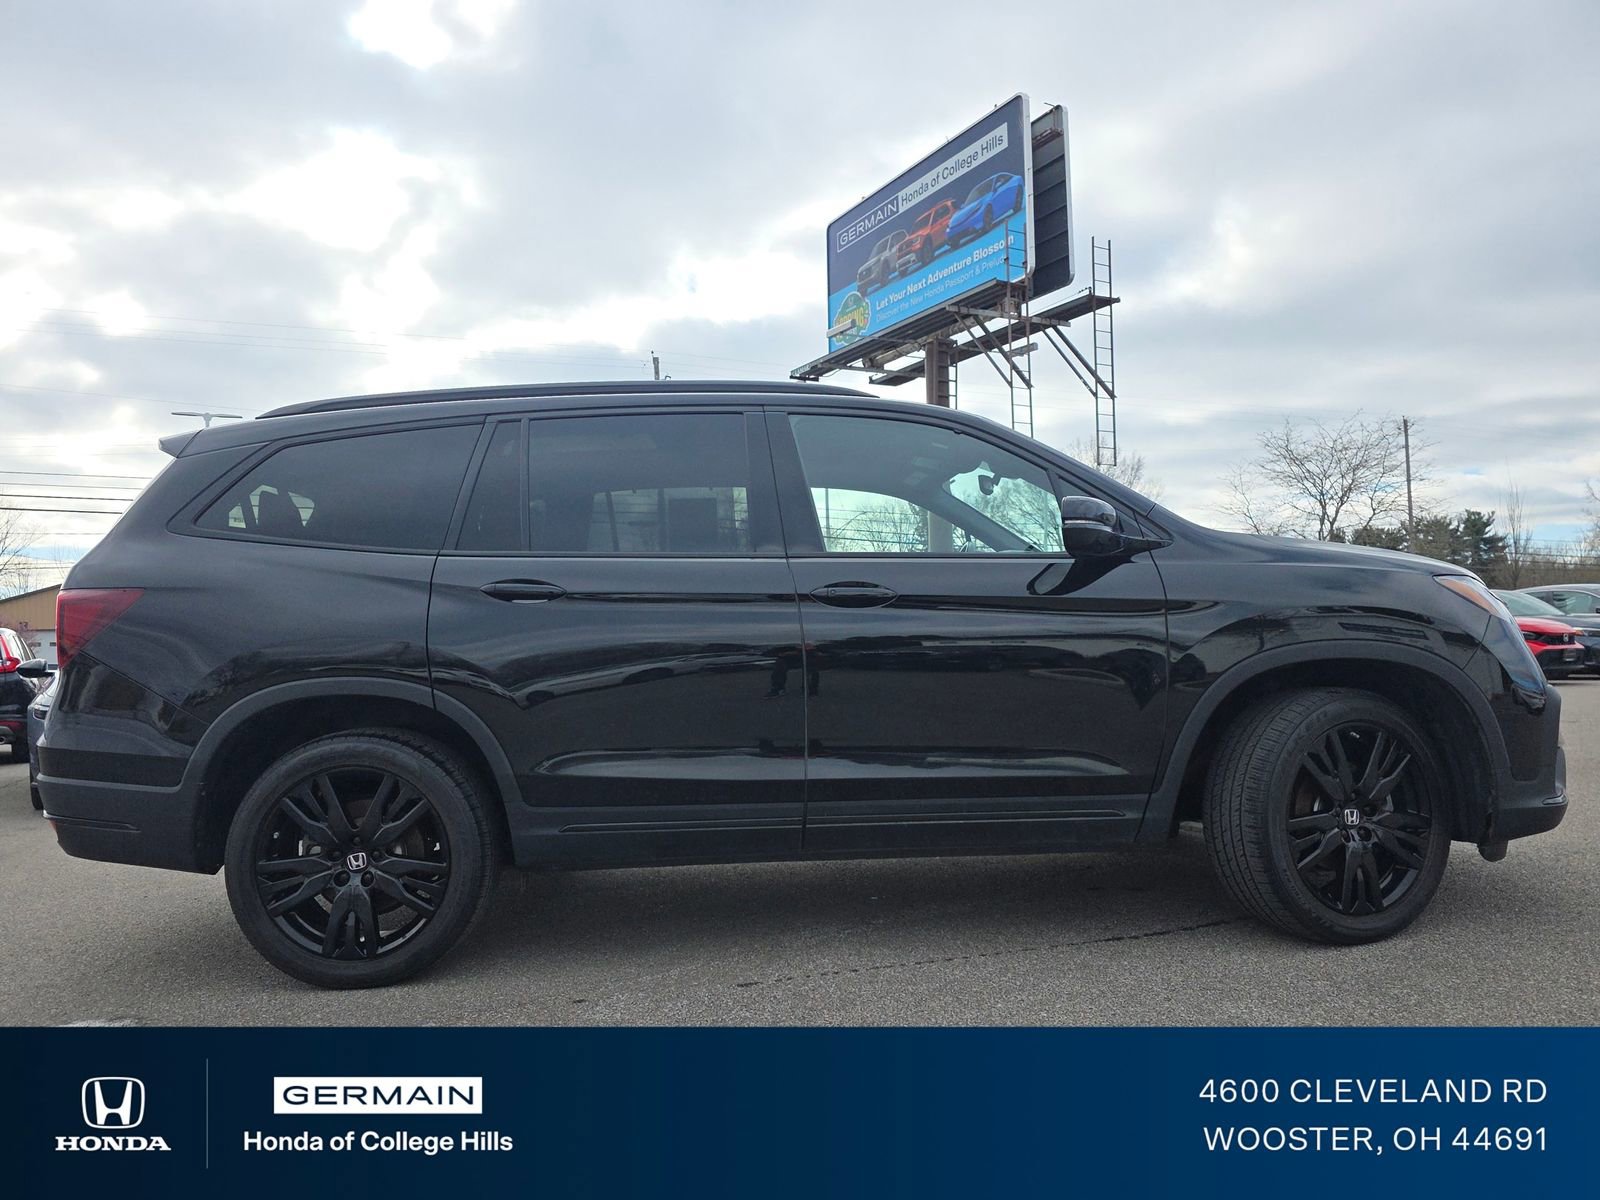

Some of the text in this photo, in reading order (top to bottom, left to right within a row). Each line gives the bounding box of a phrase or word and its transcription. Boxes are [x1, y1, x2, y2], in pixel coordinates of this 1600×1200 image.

[839, 134, 1004, 246] GERMAIN Honda of College Hills
[876, 298, 889, 310] Let
[889, 289, 906, 304] Your
[906, 278, 926, 296] Next
[927, 256, 972, 286] Adventure
[924, 283, 945, 299] Honda
[945, 269, 974, 288] Passport
[974, 264, 981, 276] &
